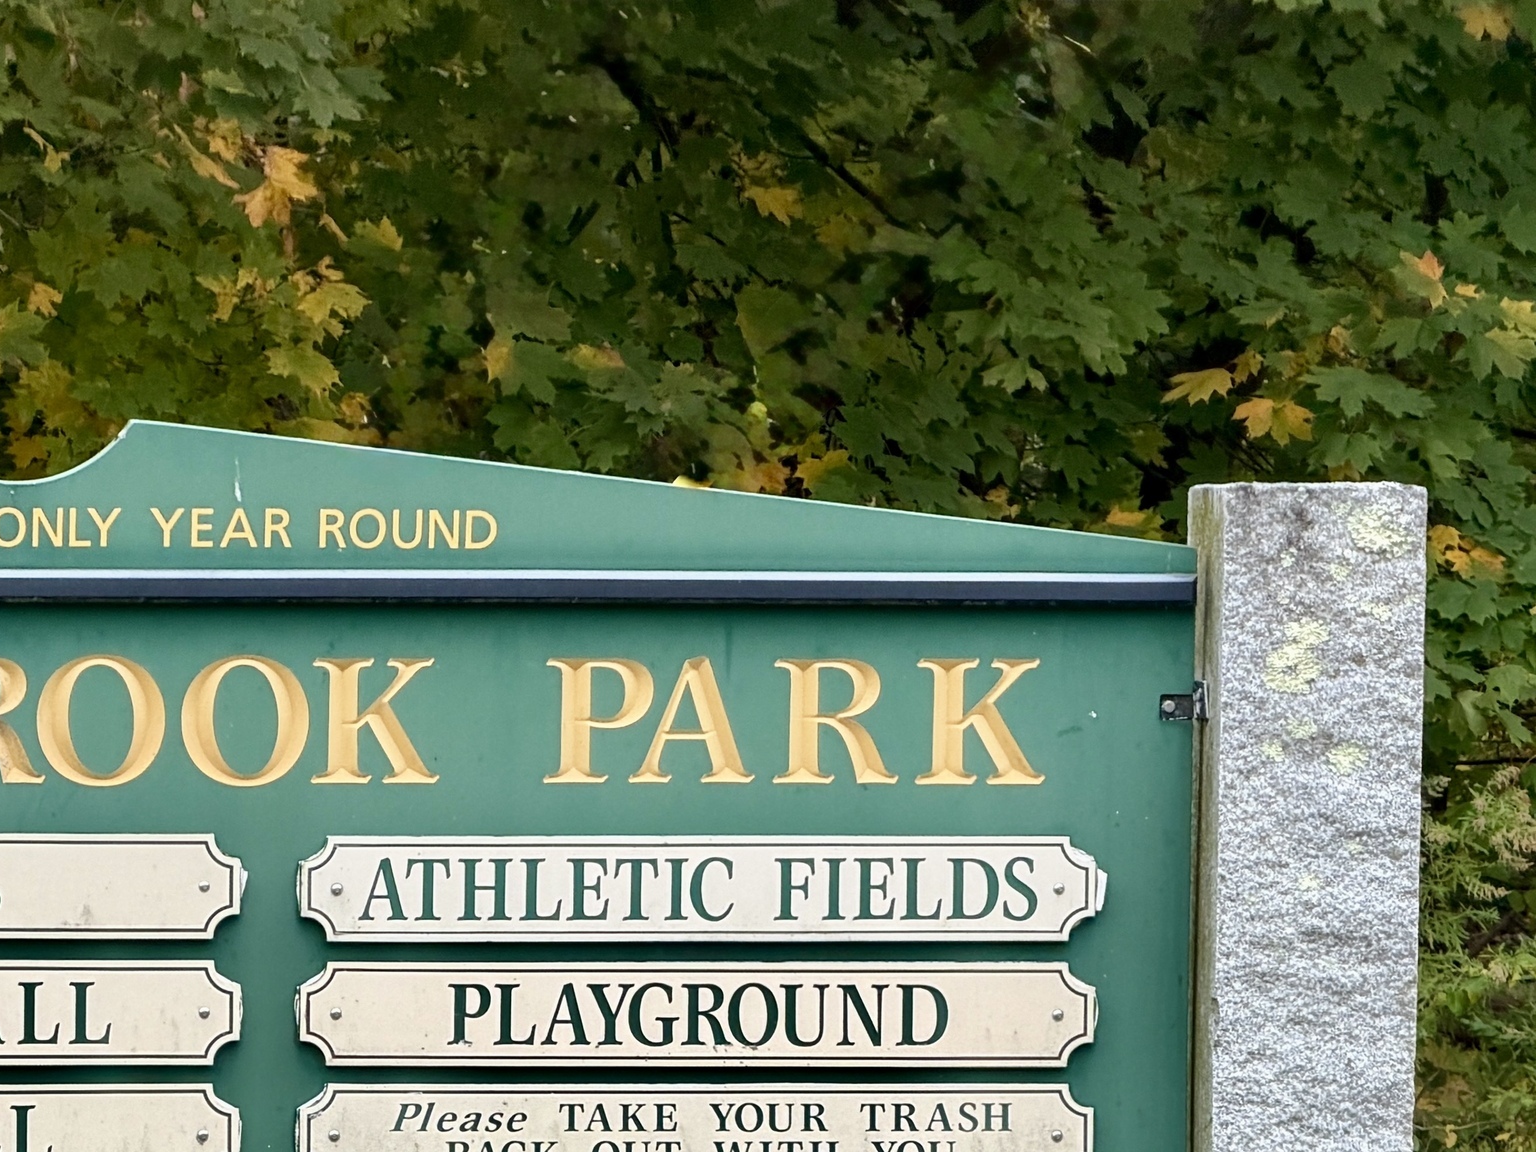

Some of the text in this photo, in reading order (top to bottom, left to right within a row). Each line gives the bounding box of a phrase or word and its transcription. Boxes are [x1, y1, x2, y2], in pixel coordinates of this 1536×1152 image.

[150, 508, 292, 549] YEAR
[318, 508, 499, 550] ROUND
[543, 656, 1045, 786] PARK
[358, 856, 1038, 922] ATHLETIC FIELDS
[447, 982, 950, 1047] PLAYGROUND
[390, 1102, 1011, 1134] Please TAKE YOUR TRASH
